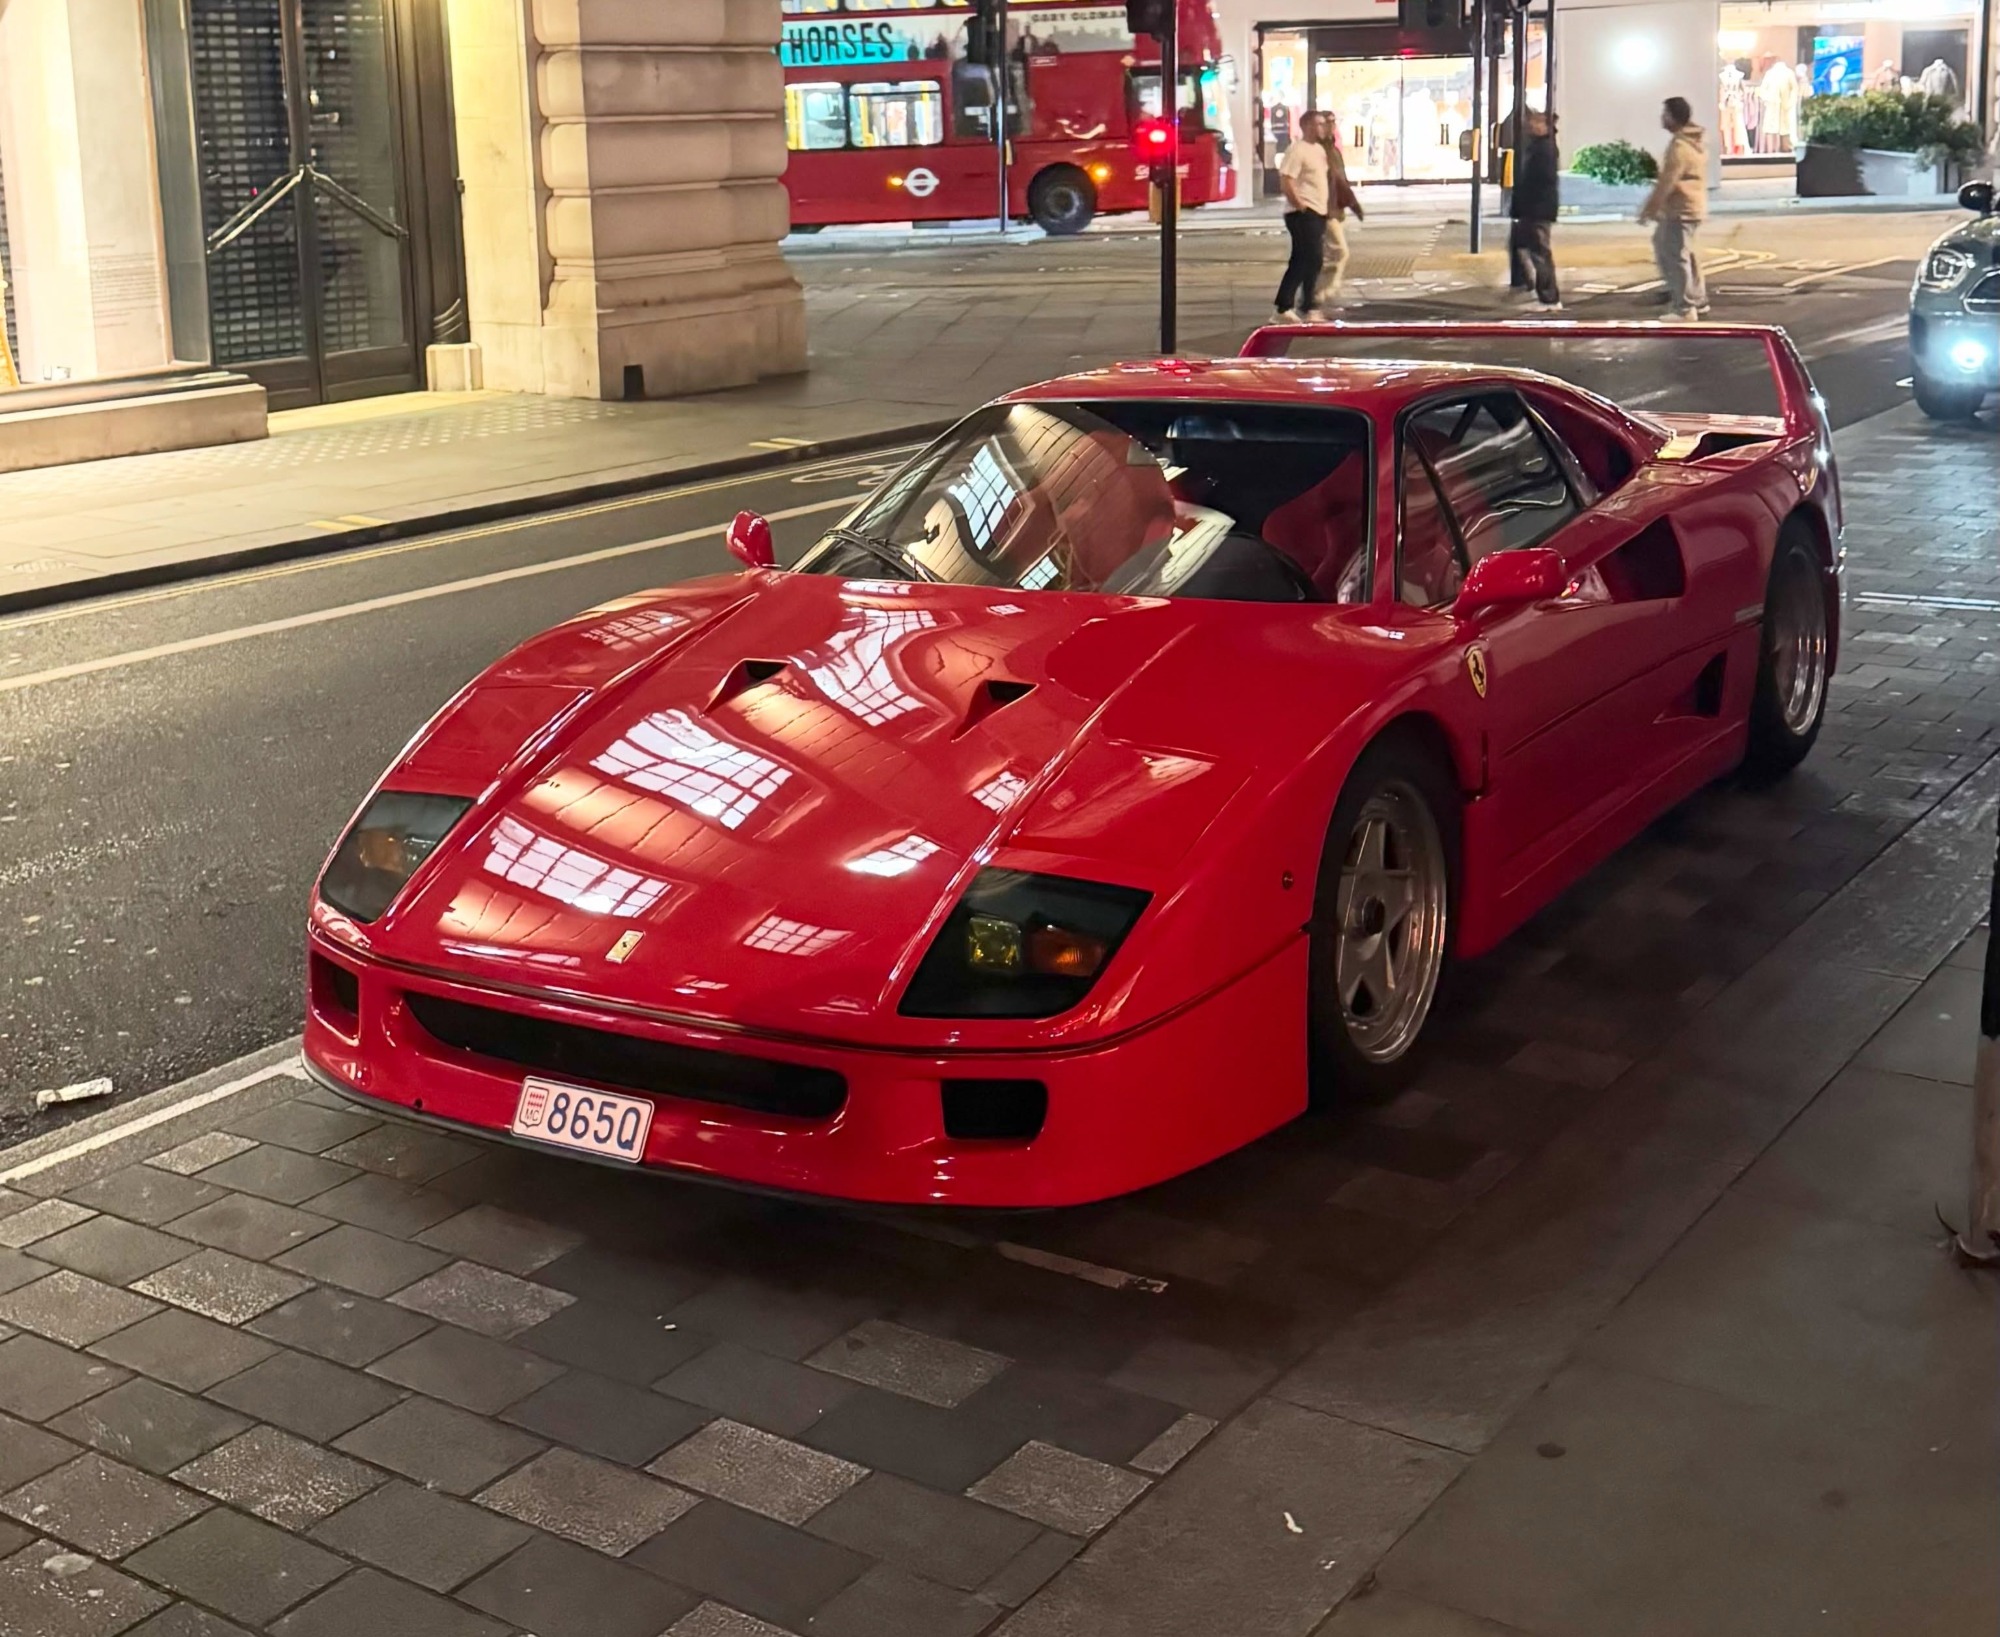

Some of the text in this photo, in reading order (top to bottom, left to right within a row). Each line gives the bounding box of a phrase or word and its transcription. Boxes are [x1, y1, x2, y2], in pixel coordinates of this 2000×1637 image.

[789, 22, 893, 64] HORSES
[524, 1108, 540, 1122] MC
[547, 1092, 641, 1151] 865Q
